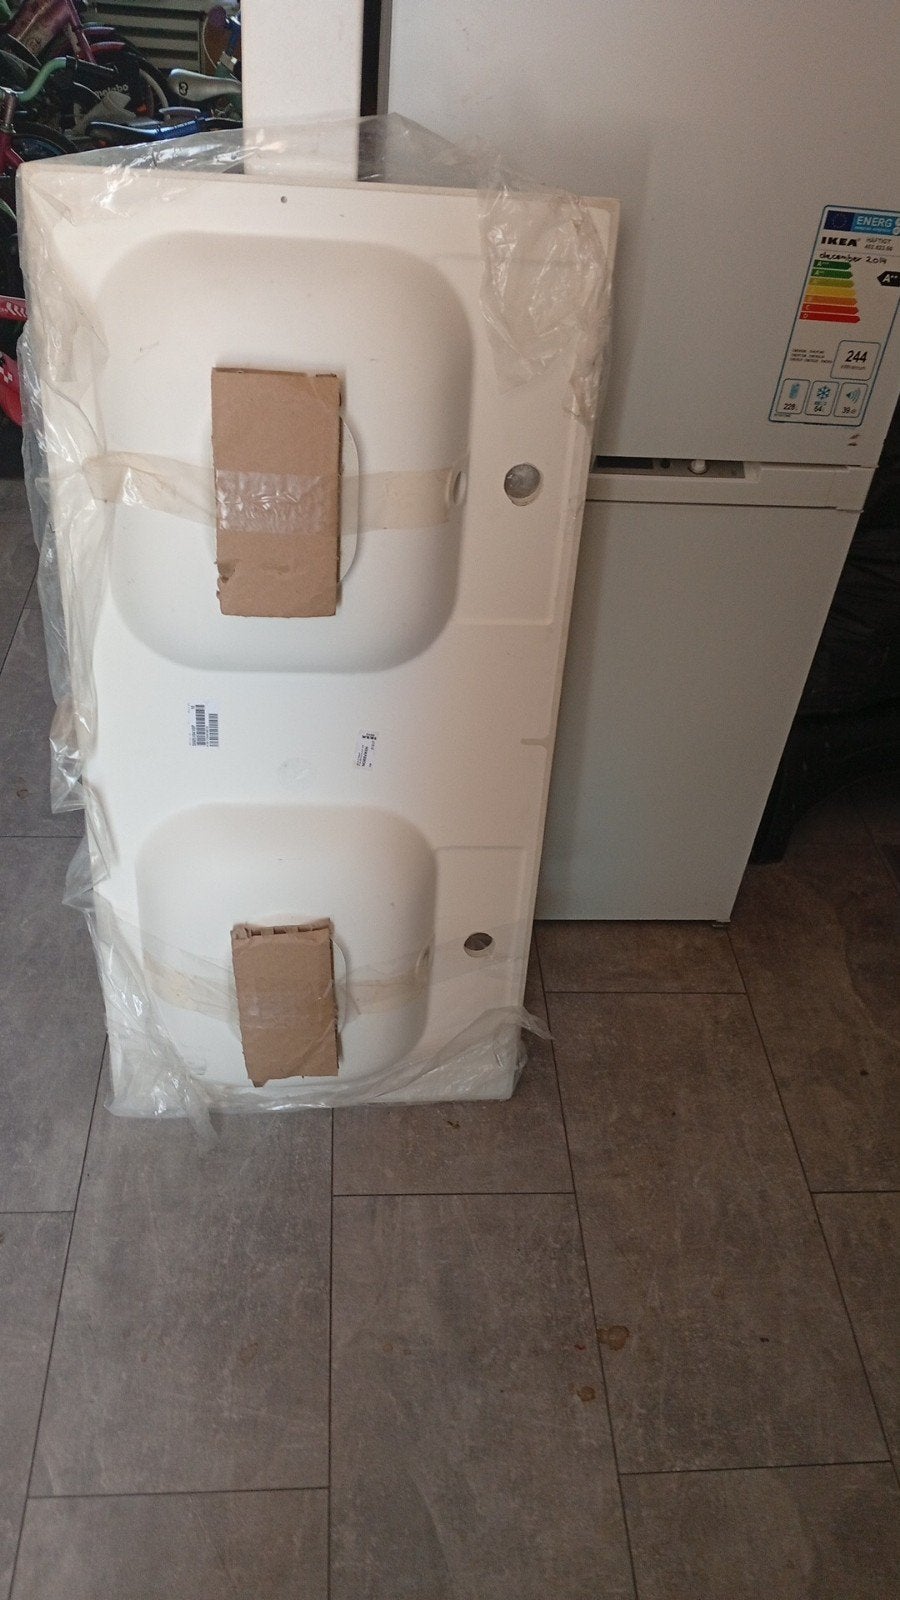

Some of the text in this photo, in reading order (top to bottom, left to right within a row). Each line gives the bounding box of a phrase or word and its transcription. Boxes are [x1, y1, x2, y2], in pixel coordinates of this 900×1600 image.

[856, 216, 893, 227] ENERG
[821, 237, 857, 247] IKEA
[819, 252, 862, 262] december
[882, 274, 898, 283] A++
[845, 350, 868, 363] 244
